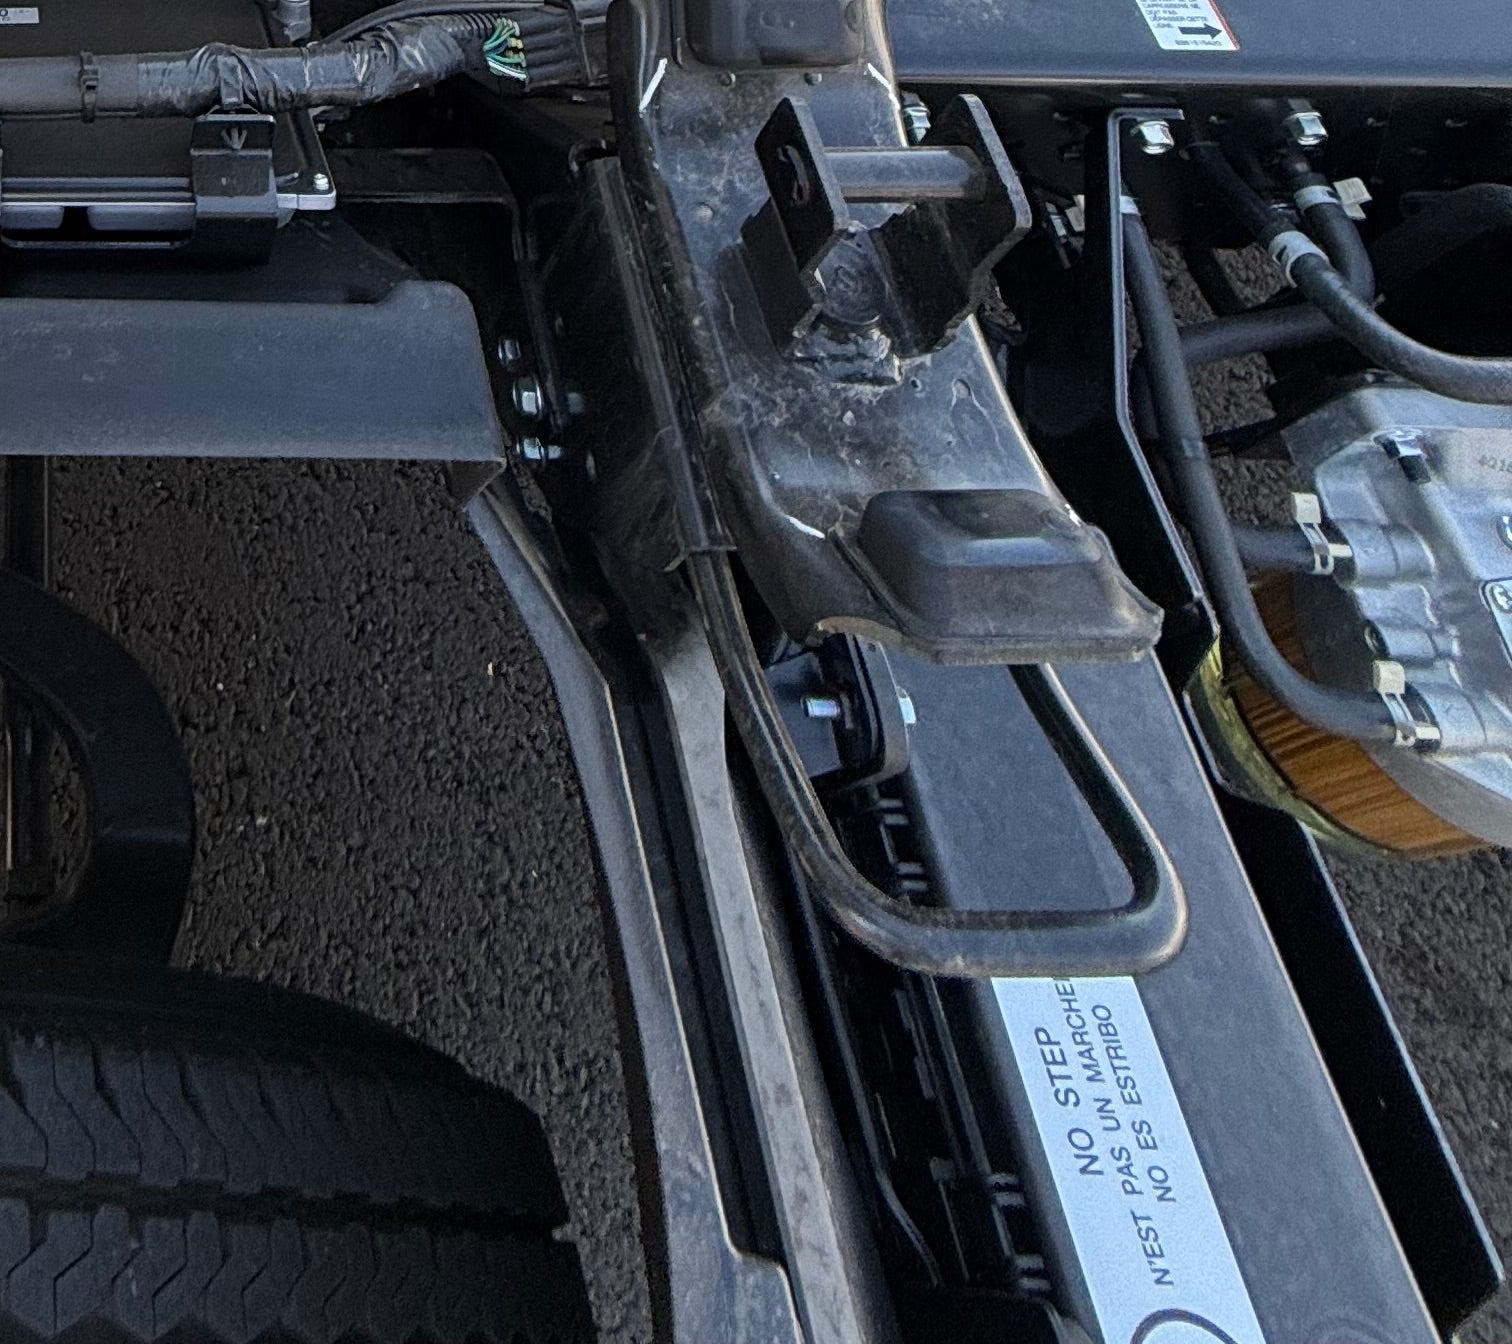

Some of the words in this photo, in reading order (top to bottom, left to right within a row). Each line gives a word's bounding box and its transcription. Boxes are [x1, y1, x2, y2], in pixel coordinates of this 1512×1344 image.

[1054, 977, 1105, 1084] MARCHE
[1091, 1004, 1142, 1106] ESTRIBO
[1034, 1027, 1080, 1108] STEP
[1093, 1098, 1121, 1132] UN
[1131, 1119, 1158, 1150] ES
[1067, 1128, 1104, 1176] NO
[1110, 1146, 1144, 1196] PAS
[1147, 1165, 1176, 1202] NO
[1130, 1209, 1174, 1286] N'EST
